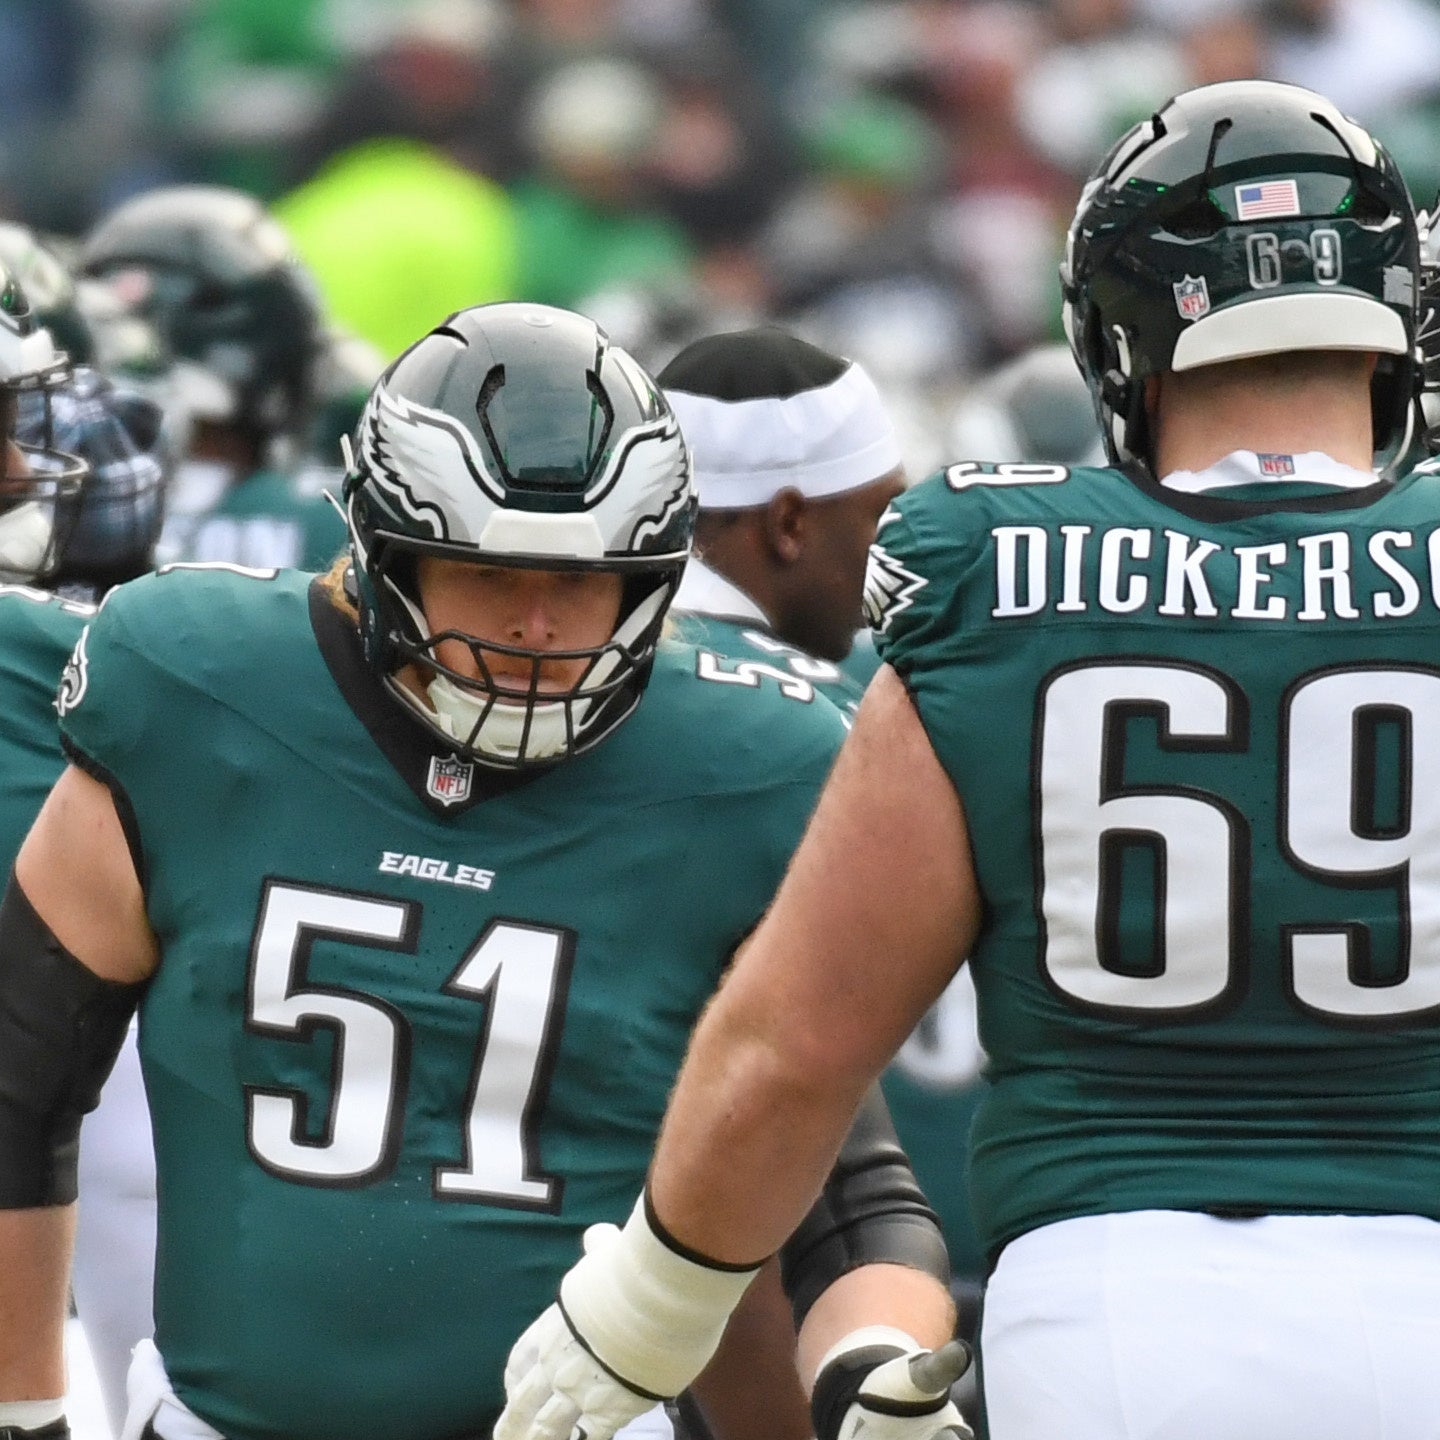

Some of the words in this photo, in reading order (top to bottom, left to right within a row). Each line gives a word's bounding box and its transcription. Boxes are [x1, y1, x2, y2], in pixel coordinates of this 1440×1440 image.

[1244, 228, 1344, 290] 69
[434, 774, 466, 796] NFL
[377, 850, 497, 892] EAGLES
[248, 884, 562, 1204] 51
